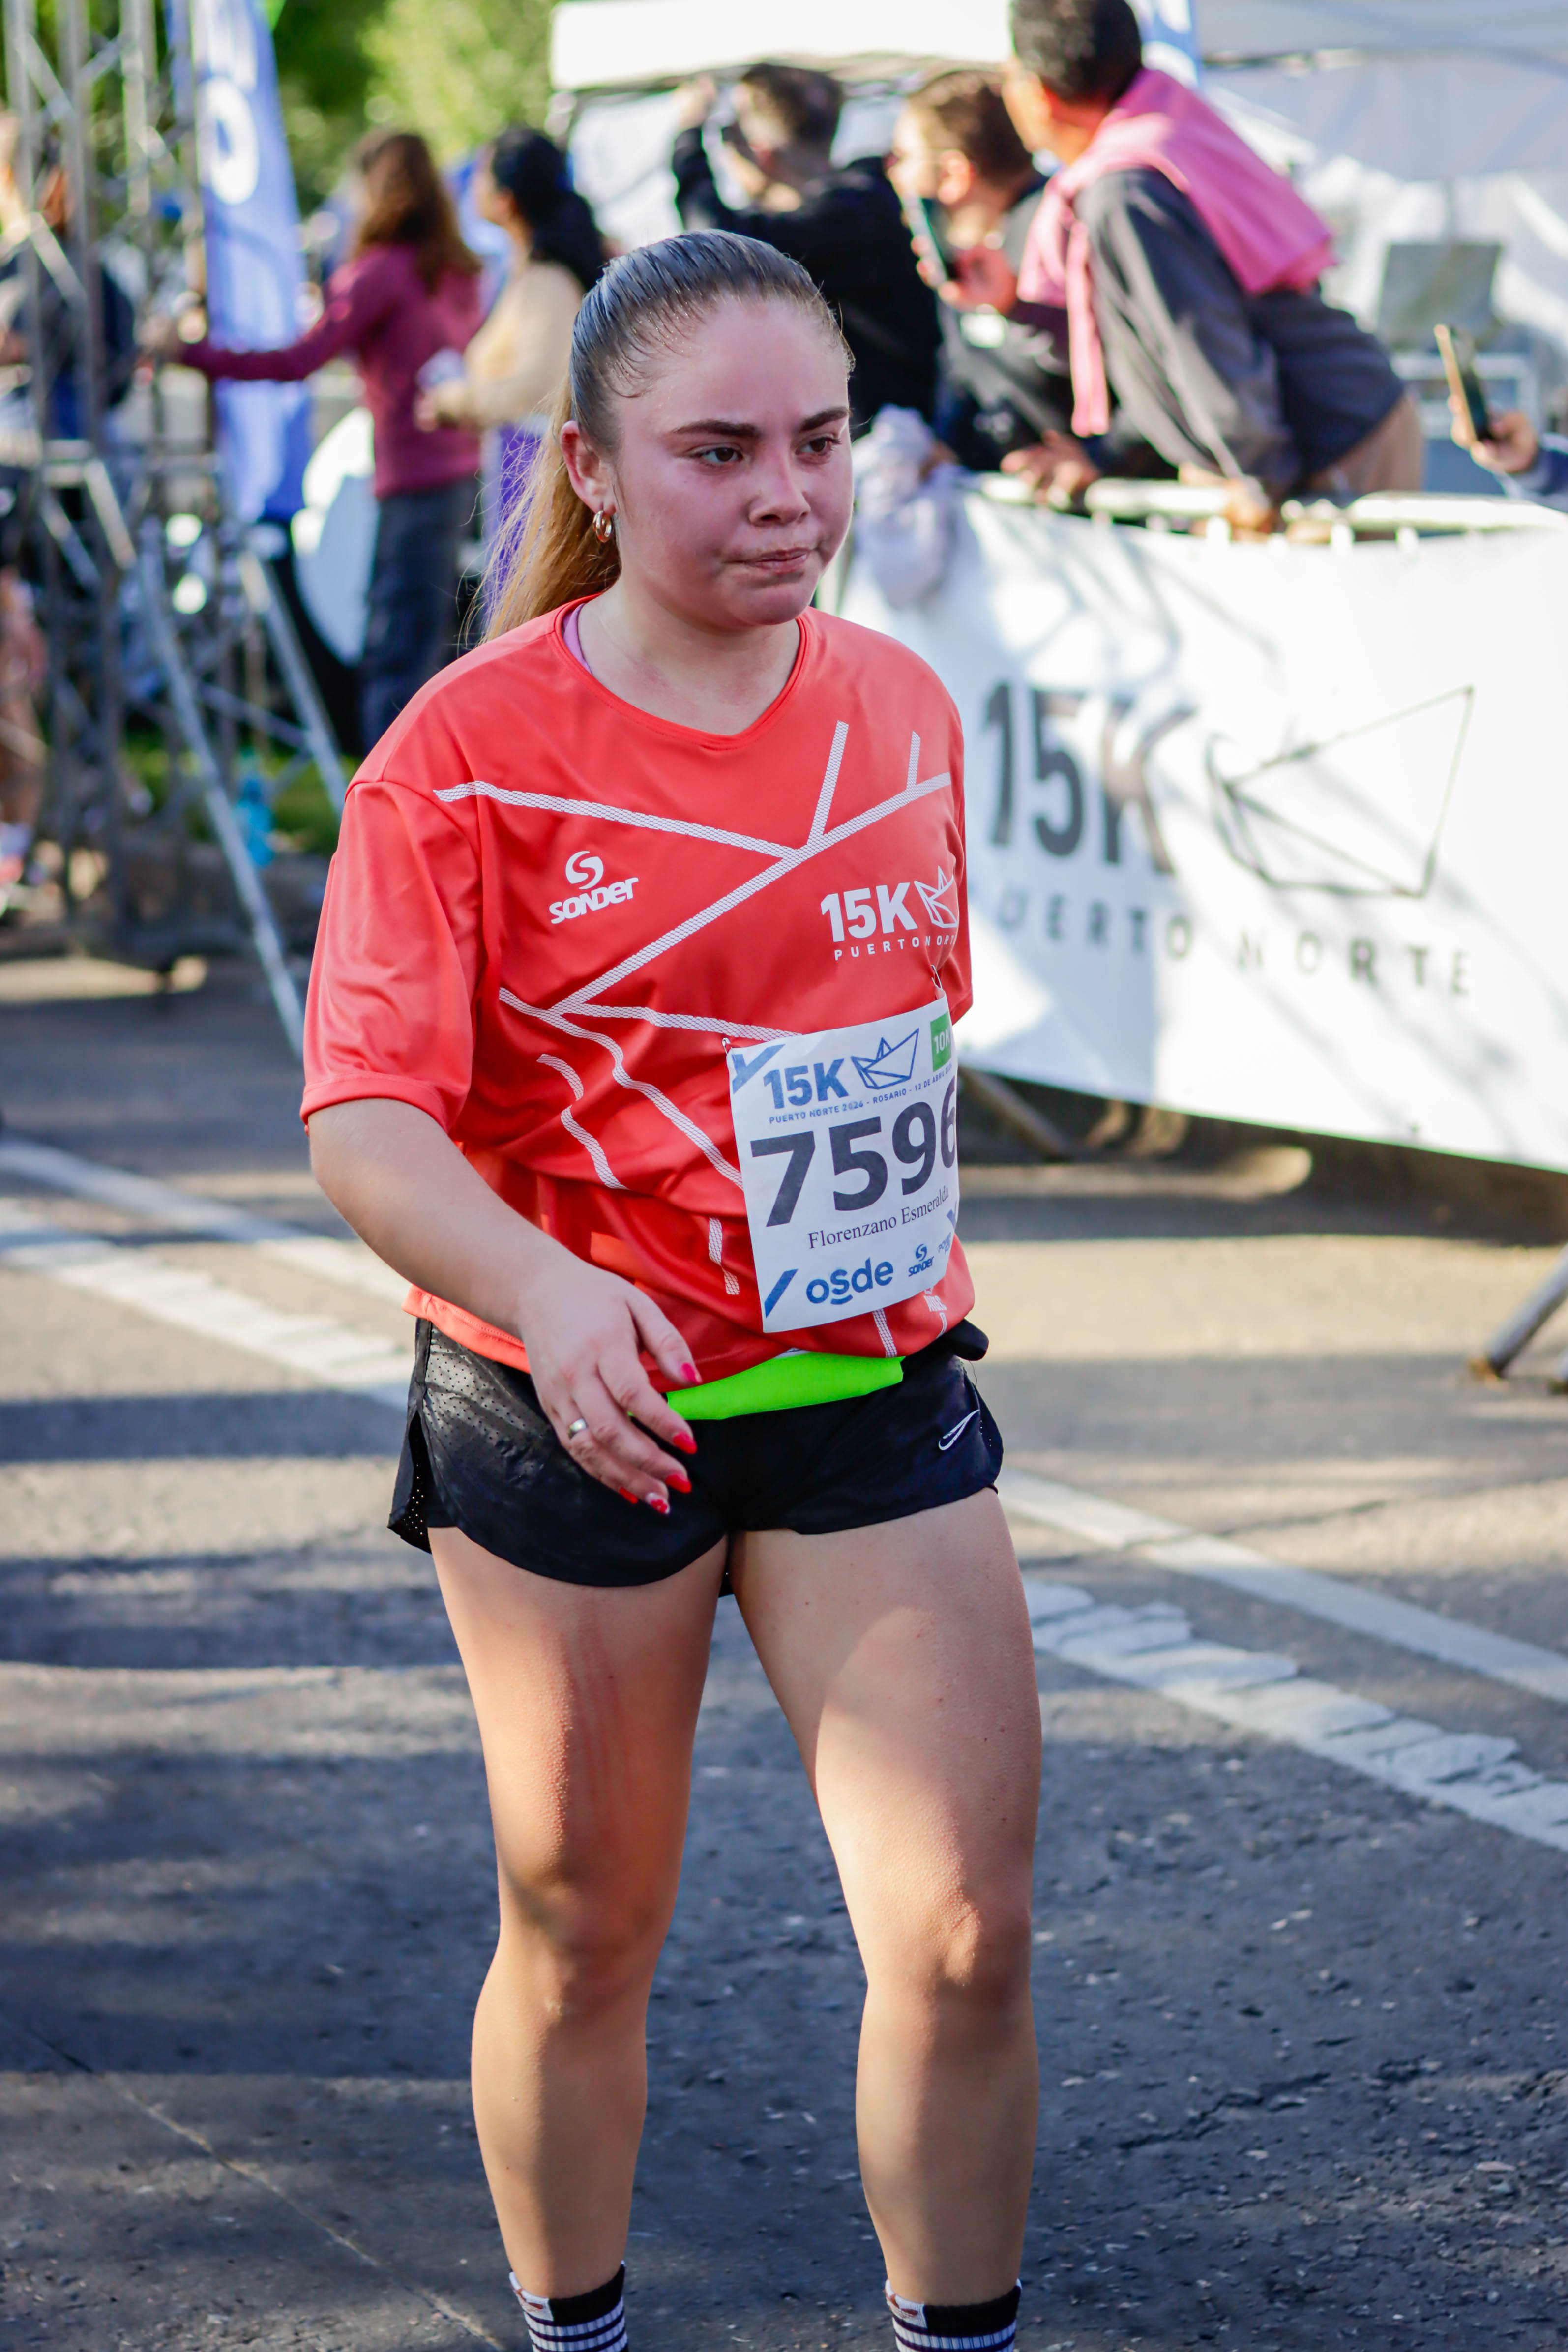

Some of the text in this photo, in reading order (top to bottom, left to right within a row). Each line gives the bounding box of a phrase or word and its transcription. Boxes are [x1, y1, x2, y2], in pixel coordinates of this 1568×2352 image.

[983, 681, 1198, 874] 15K
[820, 882, 918, 942] 15K
[969, 880, 1472, 996] UERTO NORTE
[834, 935, 956, 961] PUERTO NORT
[763, 1058, 849, 1109] 15K
[769, 1112, 806, 1124] PUERTO
[810, 1106, 839, 1117] NORTE
[842, 1101, 863, 1112] 2026
[873, 1088, 906, 1103] ROSARIO
[915, 1083, 921, 1091] 12
[924, 1079, 930, 1088] DE
[932, 1070, 944, 1083] ABRIL
[750, 1076, 956, 1227] 7596
[809, 1217, 897, 1249] Florenzano
[901, 1187, 949, 1225] Esmeralda
[806, 1257, 894, 1305] osde
